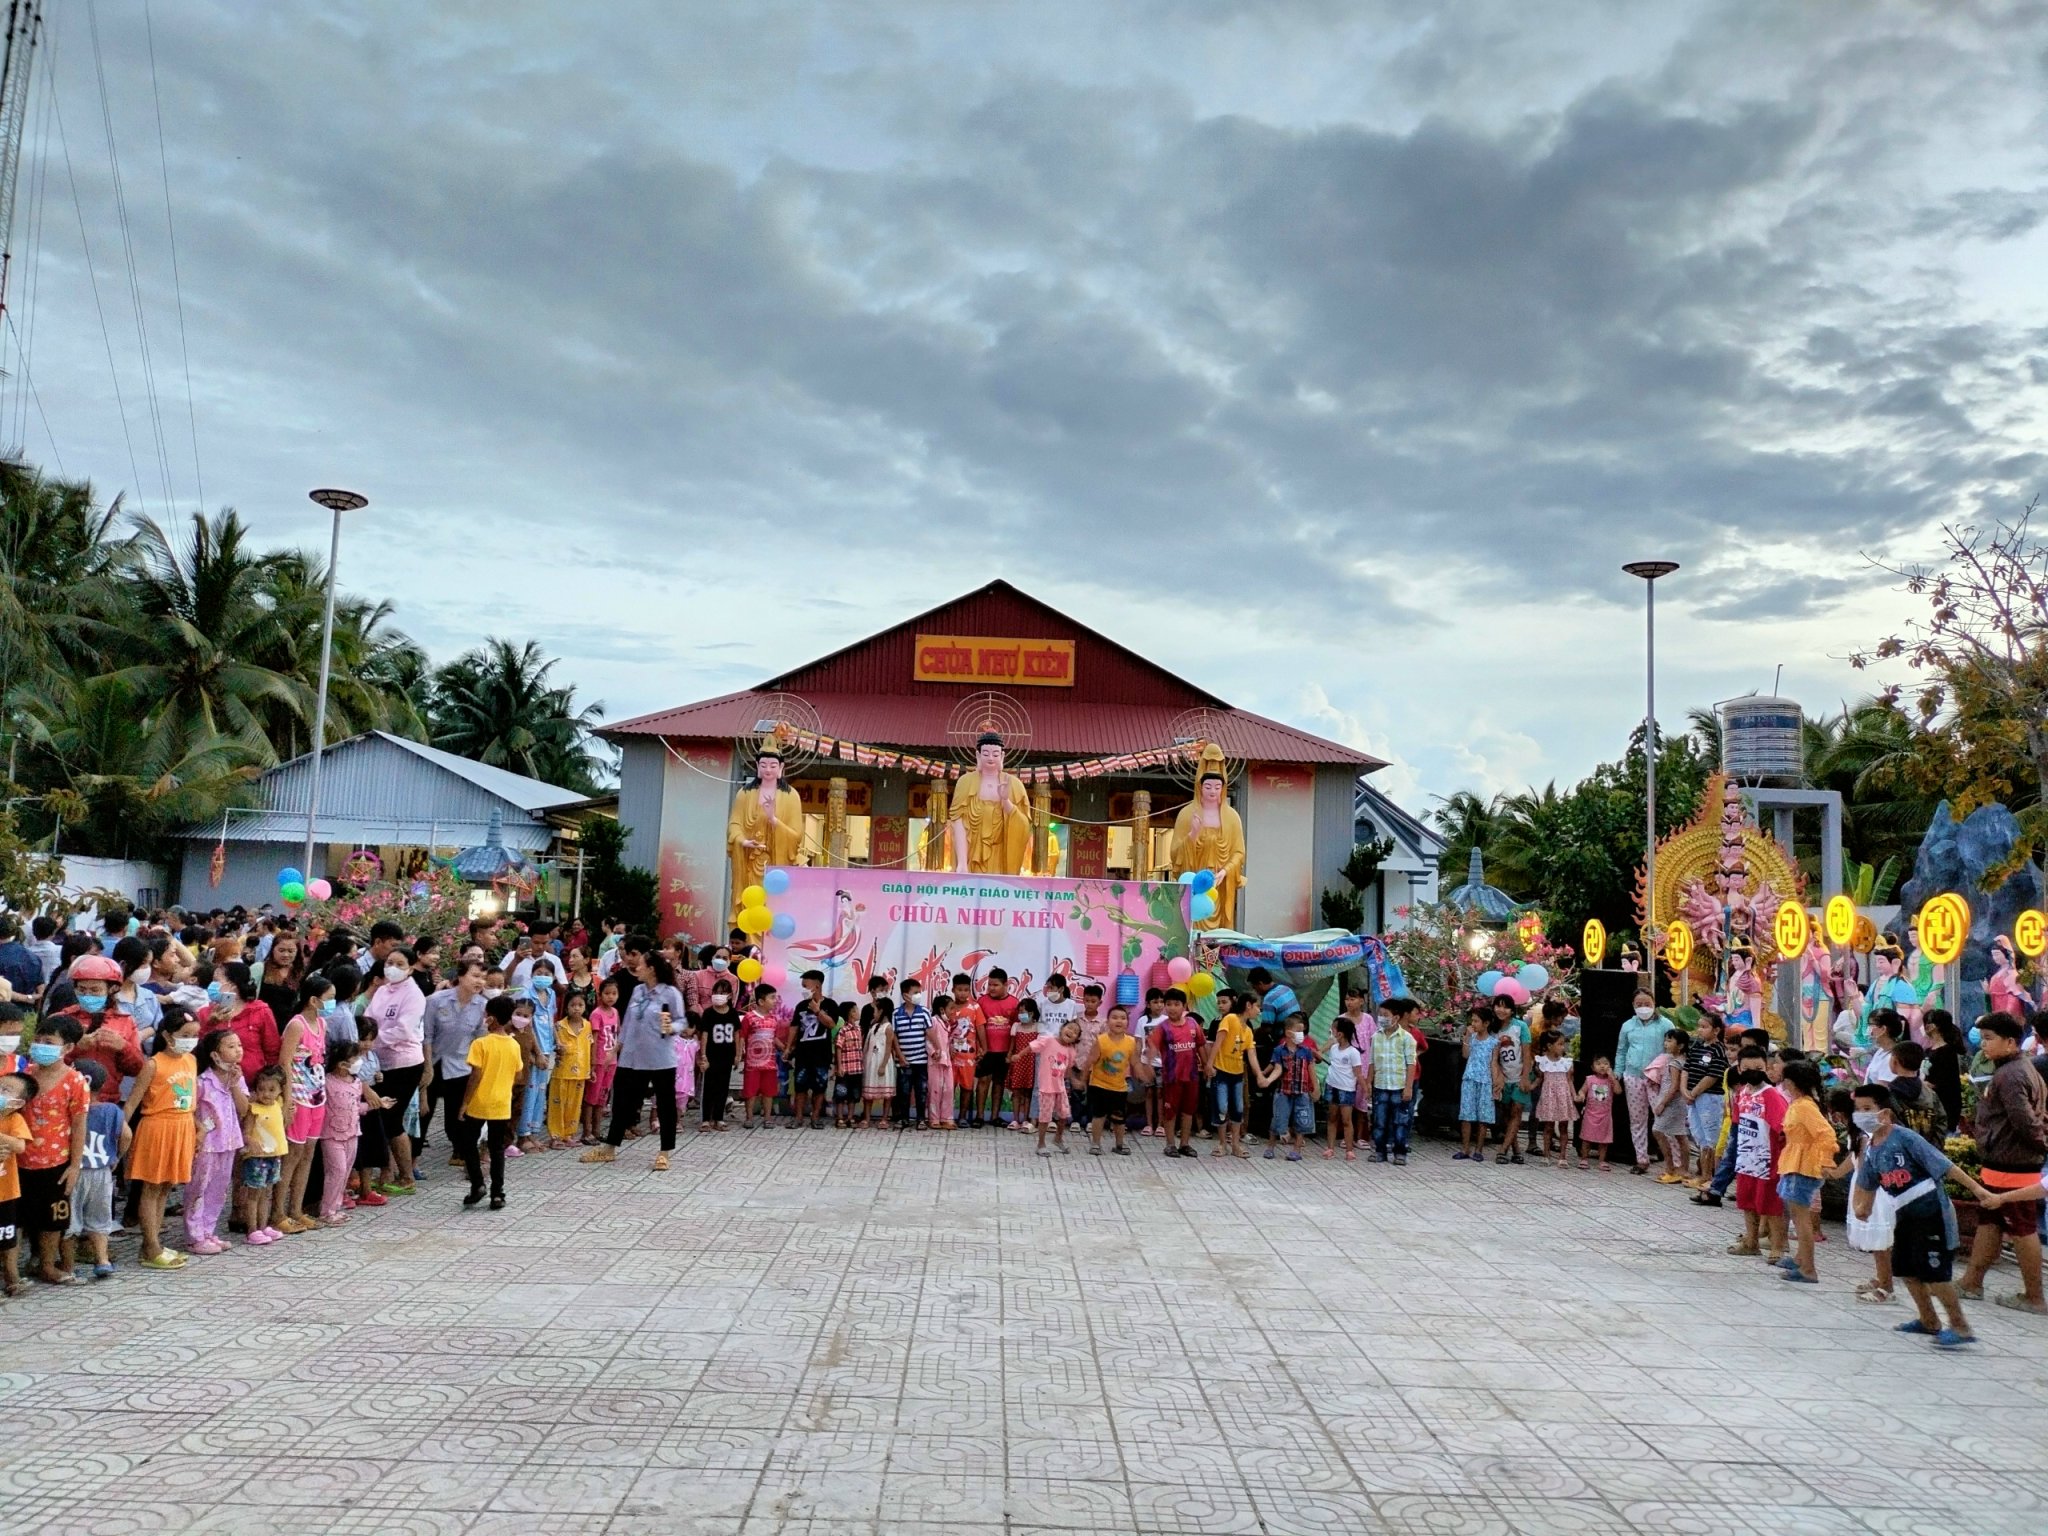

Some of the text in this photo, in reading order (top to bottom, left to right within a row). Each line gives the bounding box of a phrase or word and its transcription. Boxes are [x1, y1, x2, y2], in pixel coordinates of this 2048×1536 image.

[919, 641, 974, 675] CHÙA
[976, 644, 1021, 677] NHƯ
[882, 883, 1074, 901] GIÁO HỘI PHẬT GIÁO VIỆT NAM
[889, 902, 1065, 929] CHÙA NHƯ KIÊN
[712, 1023, 734, 1044] 69
[1501, 1049, 1516, 1062] 23
[50, 1200, 70, 1222] 19
